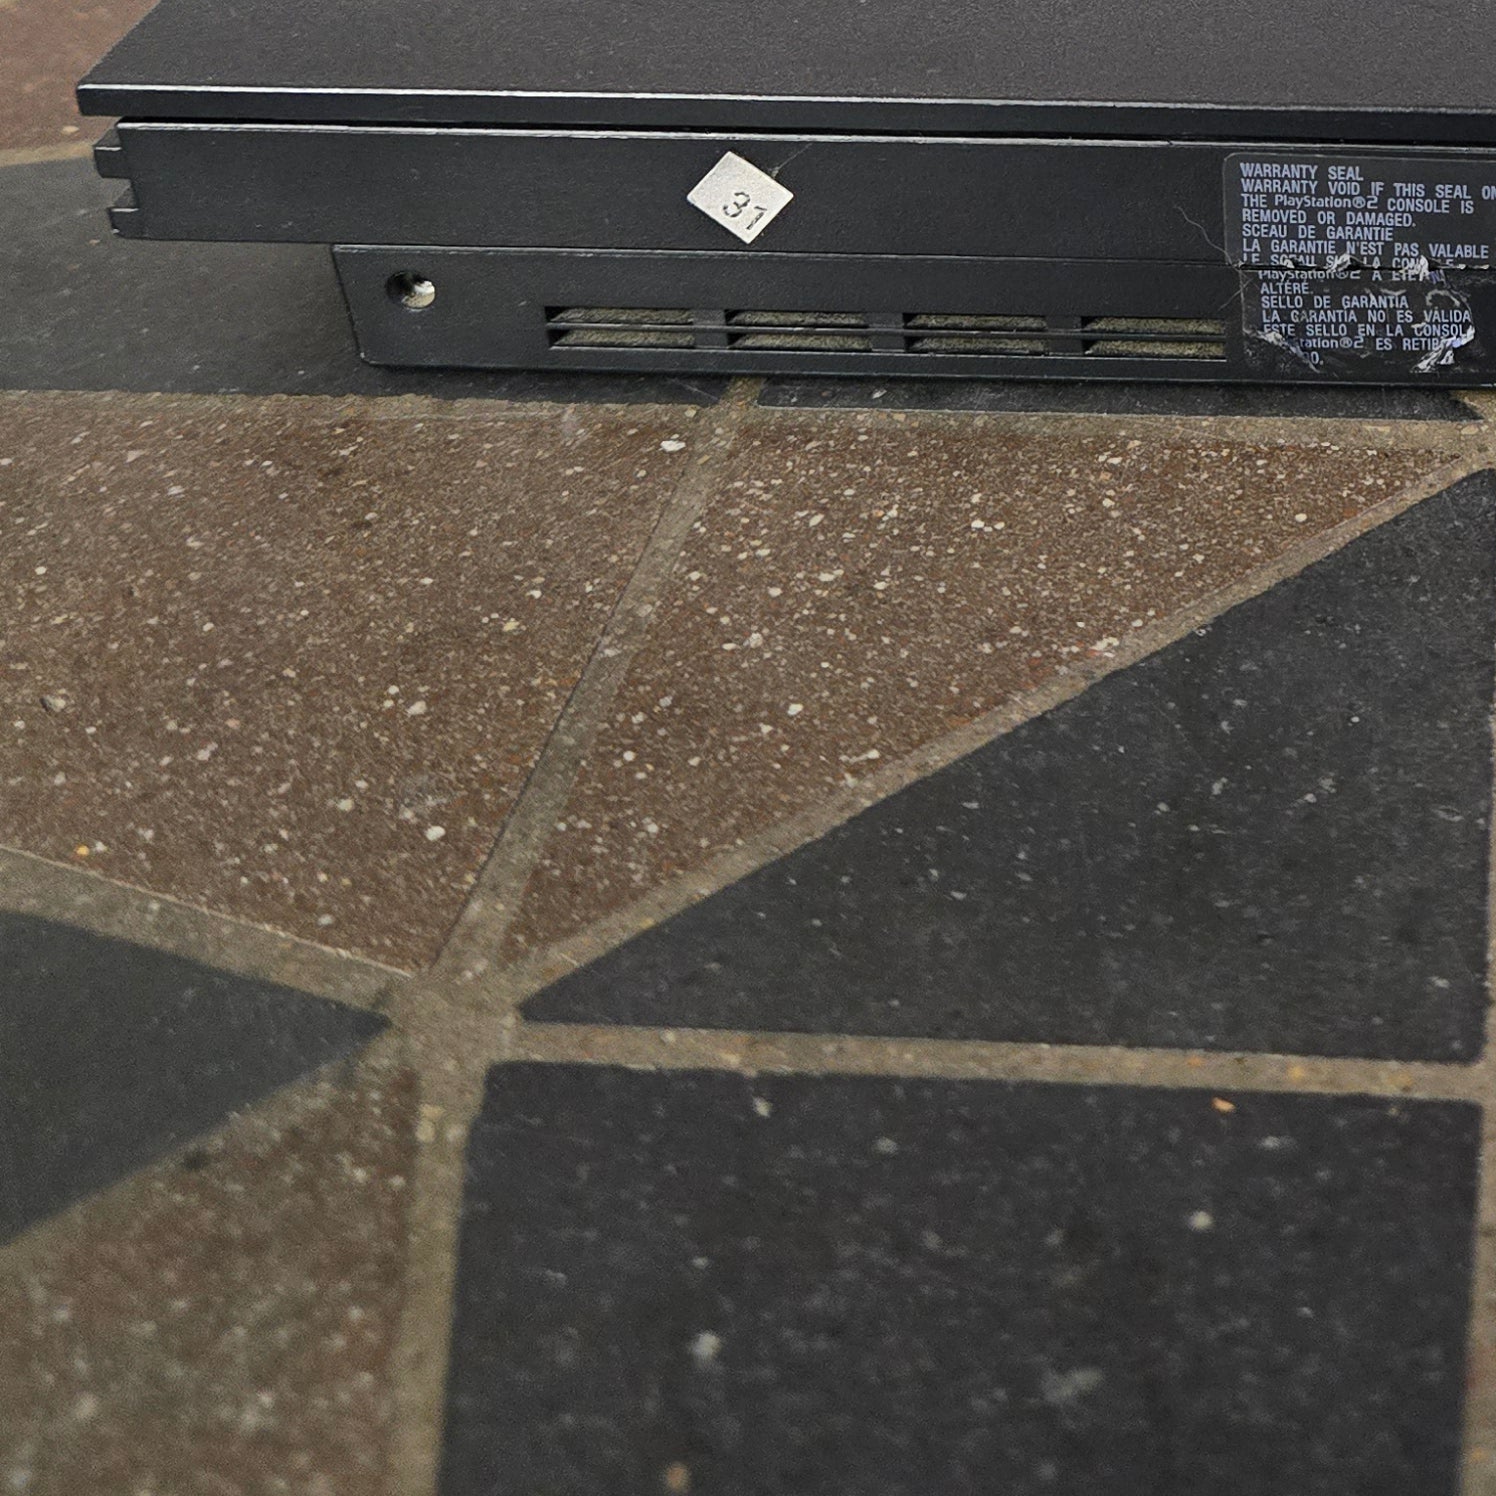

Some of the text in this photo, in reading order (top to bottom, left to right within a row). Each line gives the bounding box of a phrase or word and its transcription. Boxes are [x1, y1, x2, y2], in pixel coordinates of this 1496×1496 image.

[1240, 163, 1364, 181] WARRANTY SEAL
[1241, 179, 1318, 194] WARRANTY
[1328, 182, 1361, 195] VOID
[1371, 182, 1385, 196] IF
[1393, 183, 1425, 197] THIS
[1435, 185, 1472, 199] SEAL
[723, 191, 768, 230] 31
[1241, 194, 1268, 207] THE
[1387, 198, 1450, 213] CONSOLE
[1460, 201, 1474, 214] IS
[1242, 209, 1416, 227] REMOVED OR DAMAGED.
[1242, 224, 1394, 241] SCEAU DE GARANTIE
[1242, 238, 1261, 252] LA
[1270, 240, 1336, 254] GARANTIE
[1346, 241, 1384, 255] N'EST
[1394, 243, 1419, 256] PAS
[1428, 244, 1489, 259] VALABLE
[1261, 296, 1303, 309] SELLO
[1314, 296, 1331, 309] DE
[1262, 310, 1280, 323] LA
[1368, 310, 1386, 323] NO
[1397, 310, 1413, 323] ES
[1306, 324, 1347, 337] SELLO
[1358, 324, 1375, 337] EN
[1387, 325, 1403, 337] LA
[1376, 338, 1392, 351] ES
